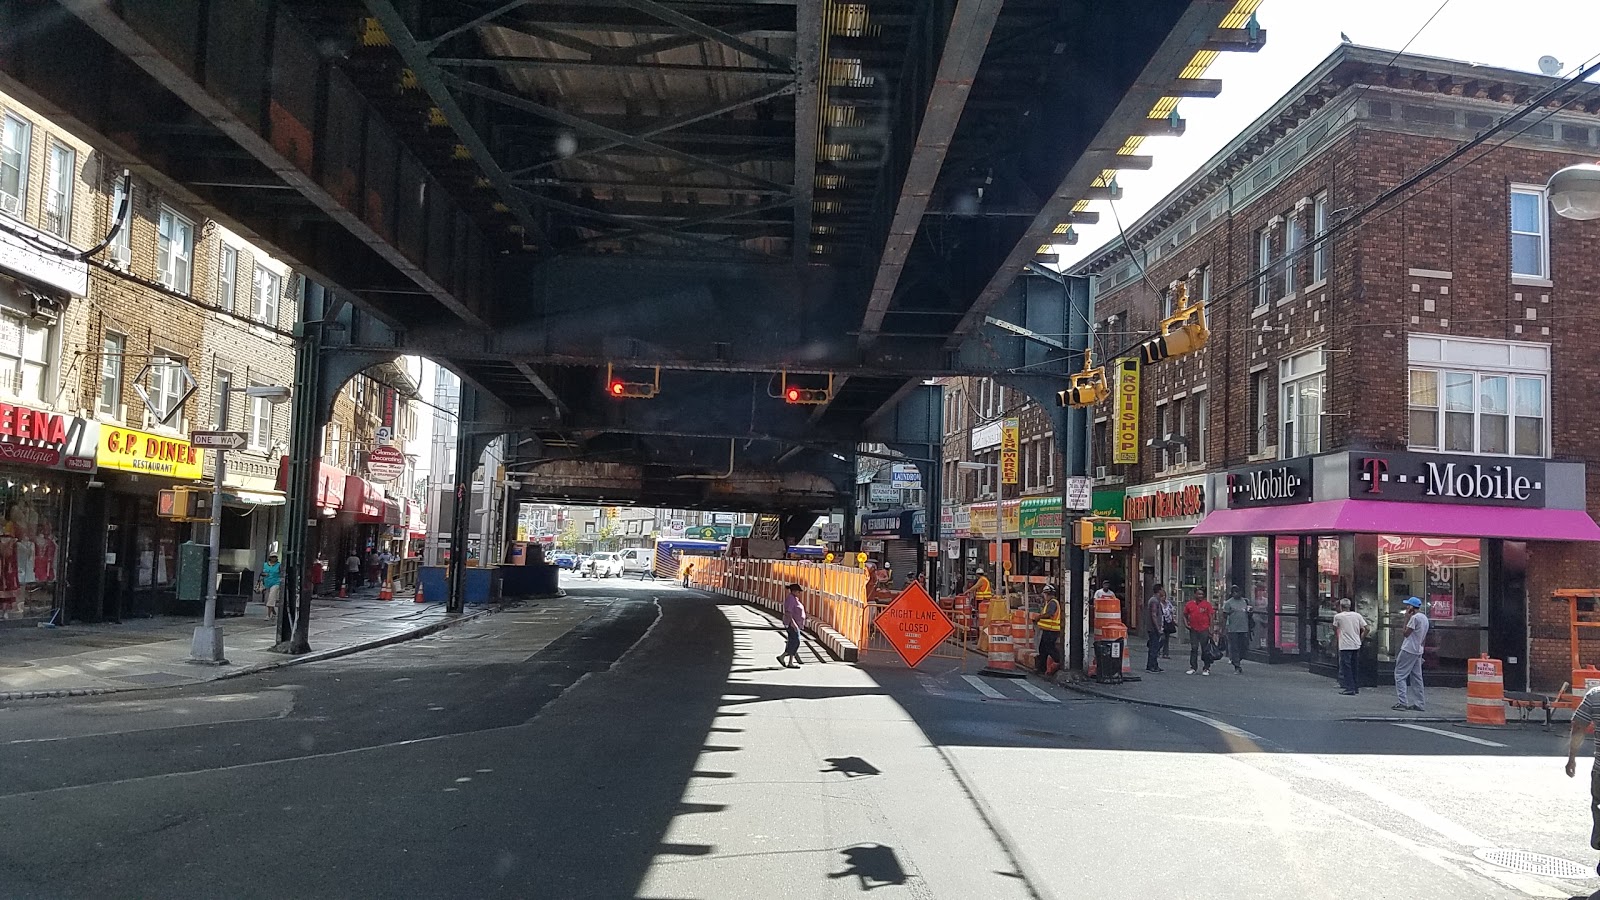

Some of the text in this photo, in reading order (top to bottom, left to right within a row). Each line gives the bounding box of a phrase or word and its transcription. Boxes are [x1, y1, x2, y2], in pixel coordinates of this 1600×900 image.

[195, 435, 239, 445] ONE WAY
[1004, 428, 1016, 448] FISH
[0, 442, 54, 463] Boutique
[108, 431, 198, 466] G.P. DINER
[374, 448, 400, 456] Glamour
[133, 459, 173, 473] RESTAURANT
[371, 454, 402, 463] Decorating
[1003, 453, 1017, 482] MARKET
[1426, 461, 1531, 500] Mobile
[1155, 489, 1183, 518] DEALS
[890, 608, 937, 621] RIGHT LANE
[899, 622, 929, 633] CLOSED
